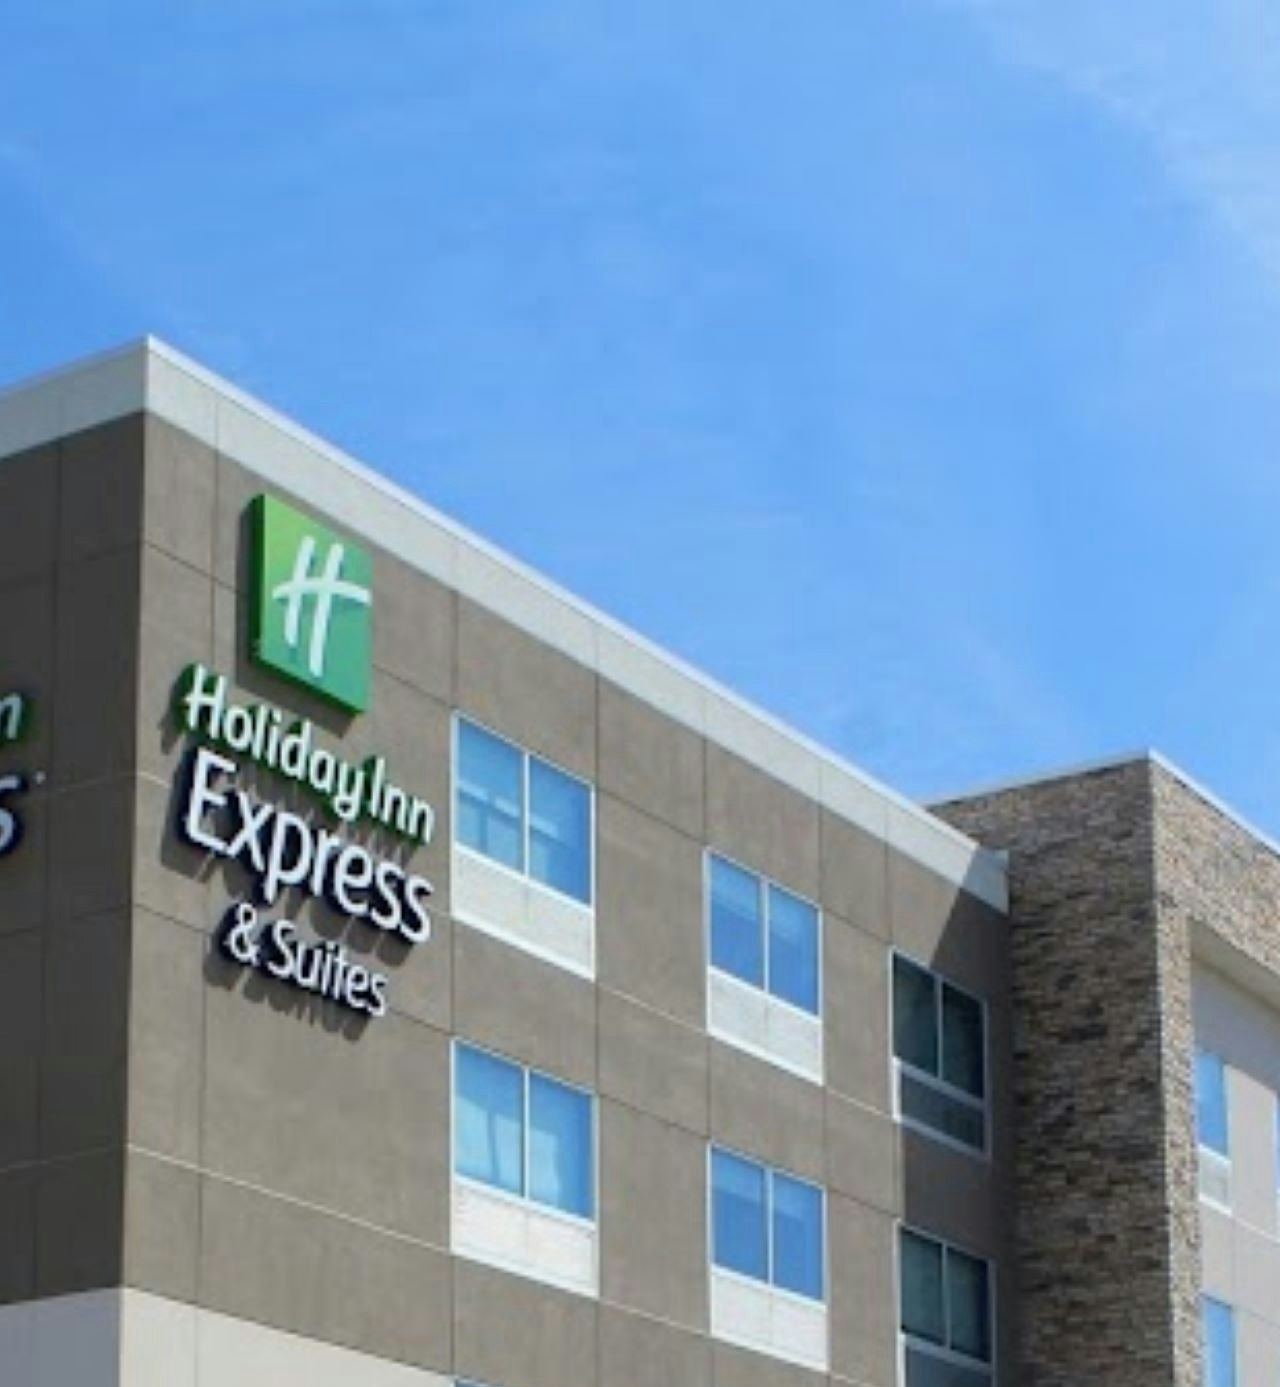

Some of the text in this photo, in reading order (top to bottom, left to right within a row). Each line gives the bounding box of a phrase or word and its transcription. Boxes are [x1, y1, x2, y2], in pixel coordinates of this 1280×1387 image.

[272, 536, 372, 678] H
[185, 663, 434, 844] Holiday Inn
[185, 746, 432, 945] Express
[224, 902, 386, 1018] & Suites
